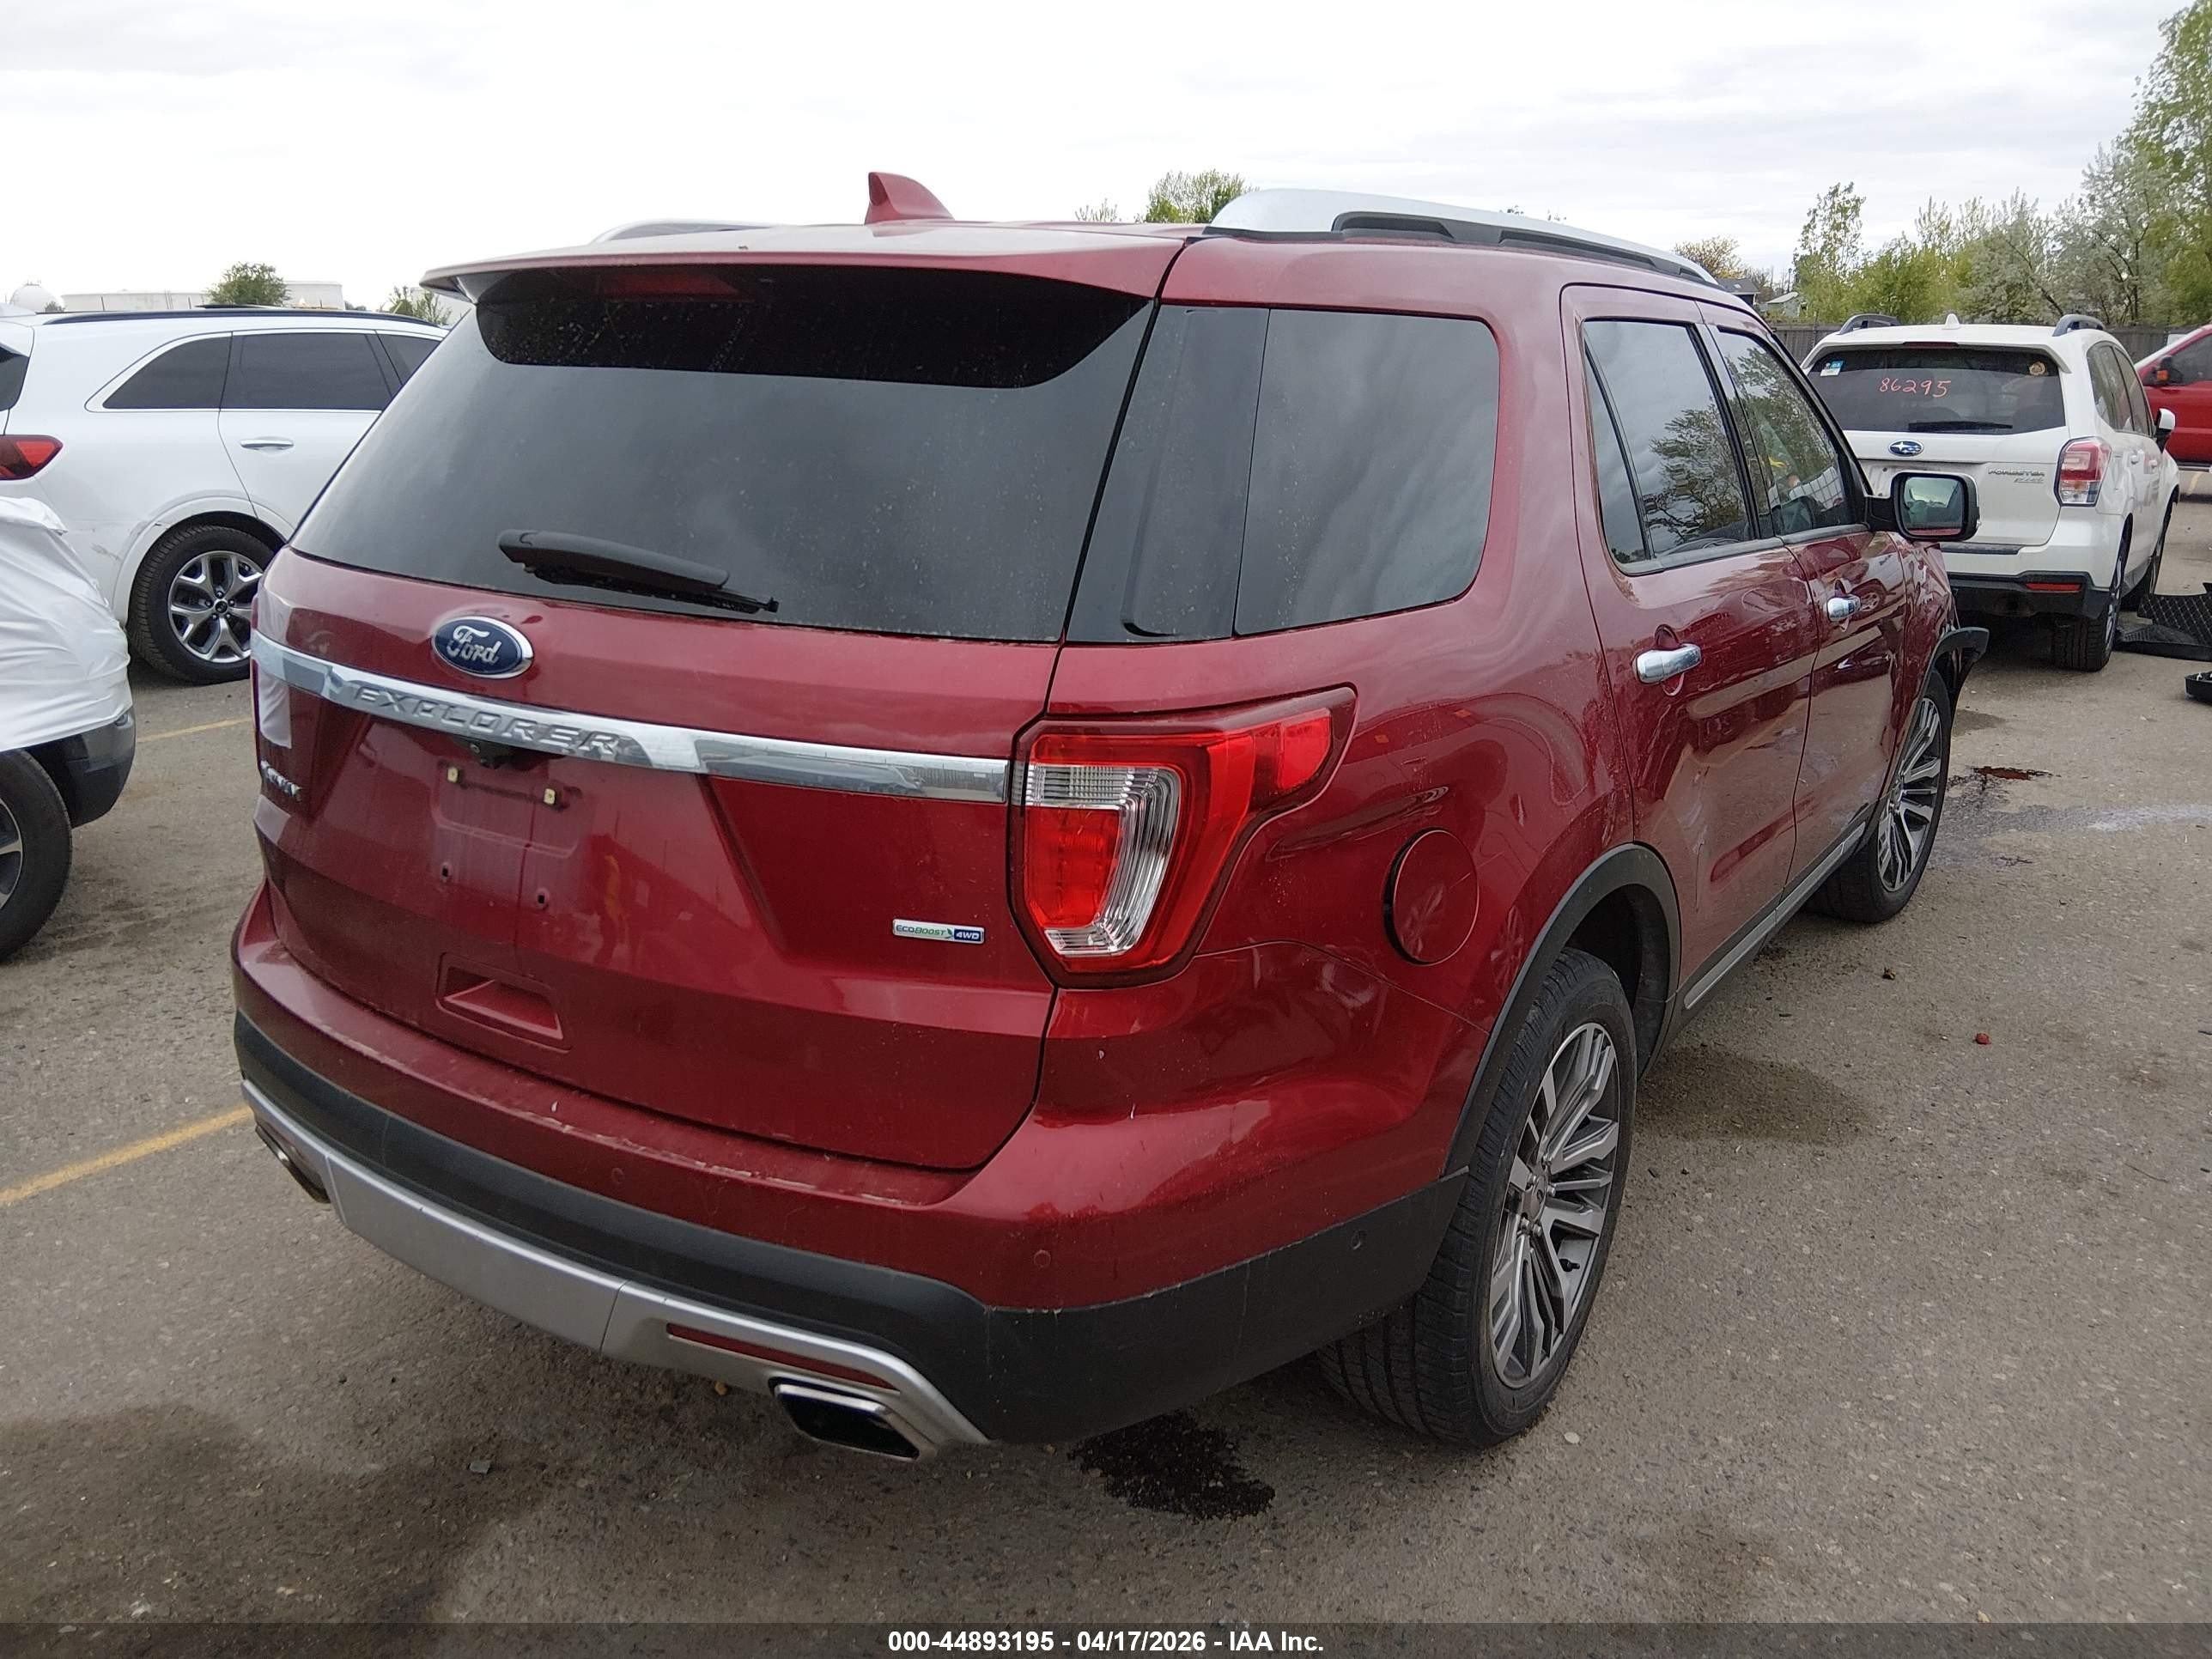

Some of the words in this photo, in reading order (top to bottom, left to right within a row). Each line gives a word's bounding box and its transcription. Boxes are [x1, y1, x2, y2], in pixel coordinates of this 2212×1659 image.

[1879, 377, 1952, 398] 86295
[446, 624, 501, 665] Ford
[352, 685, 620, 756] EXPLORER
[955, 931, 981, 940] 4WD
